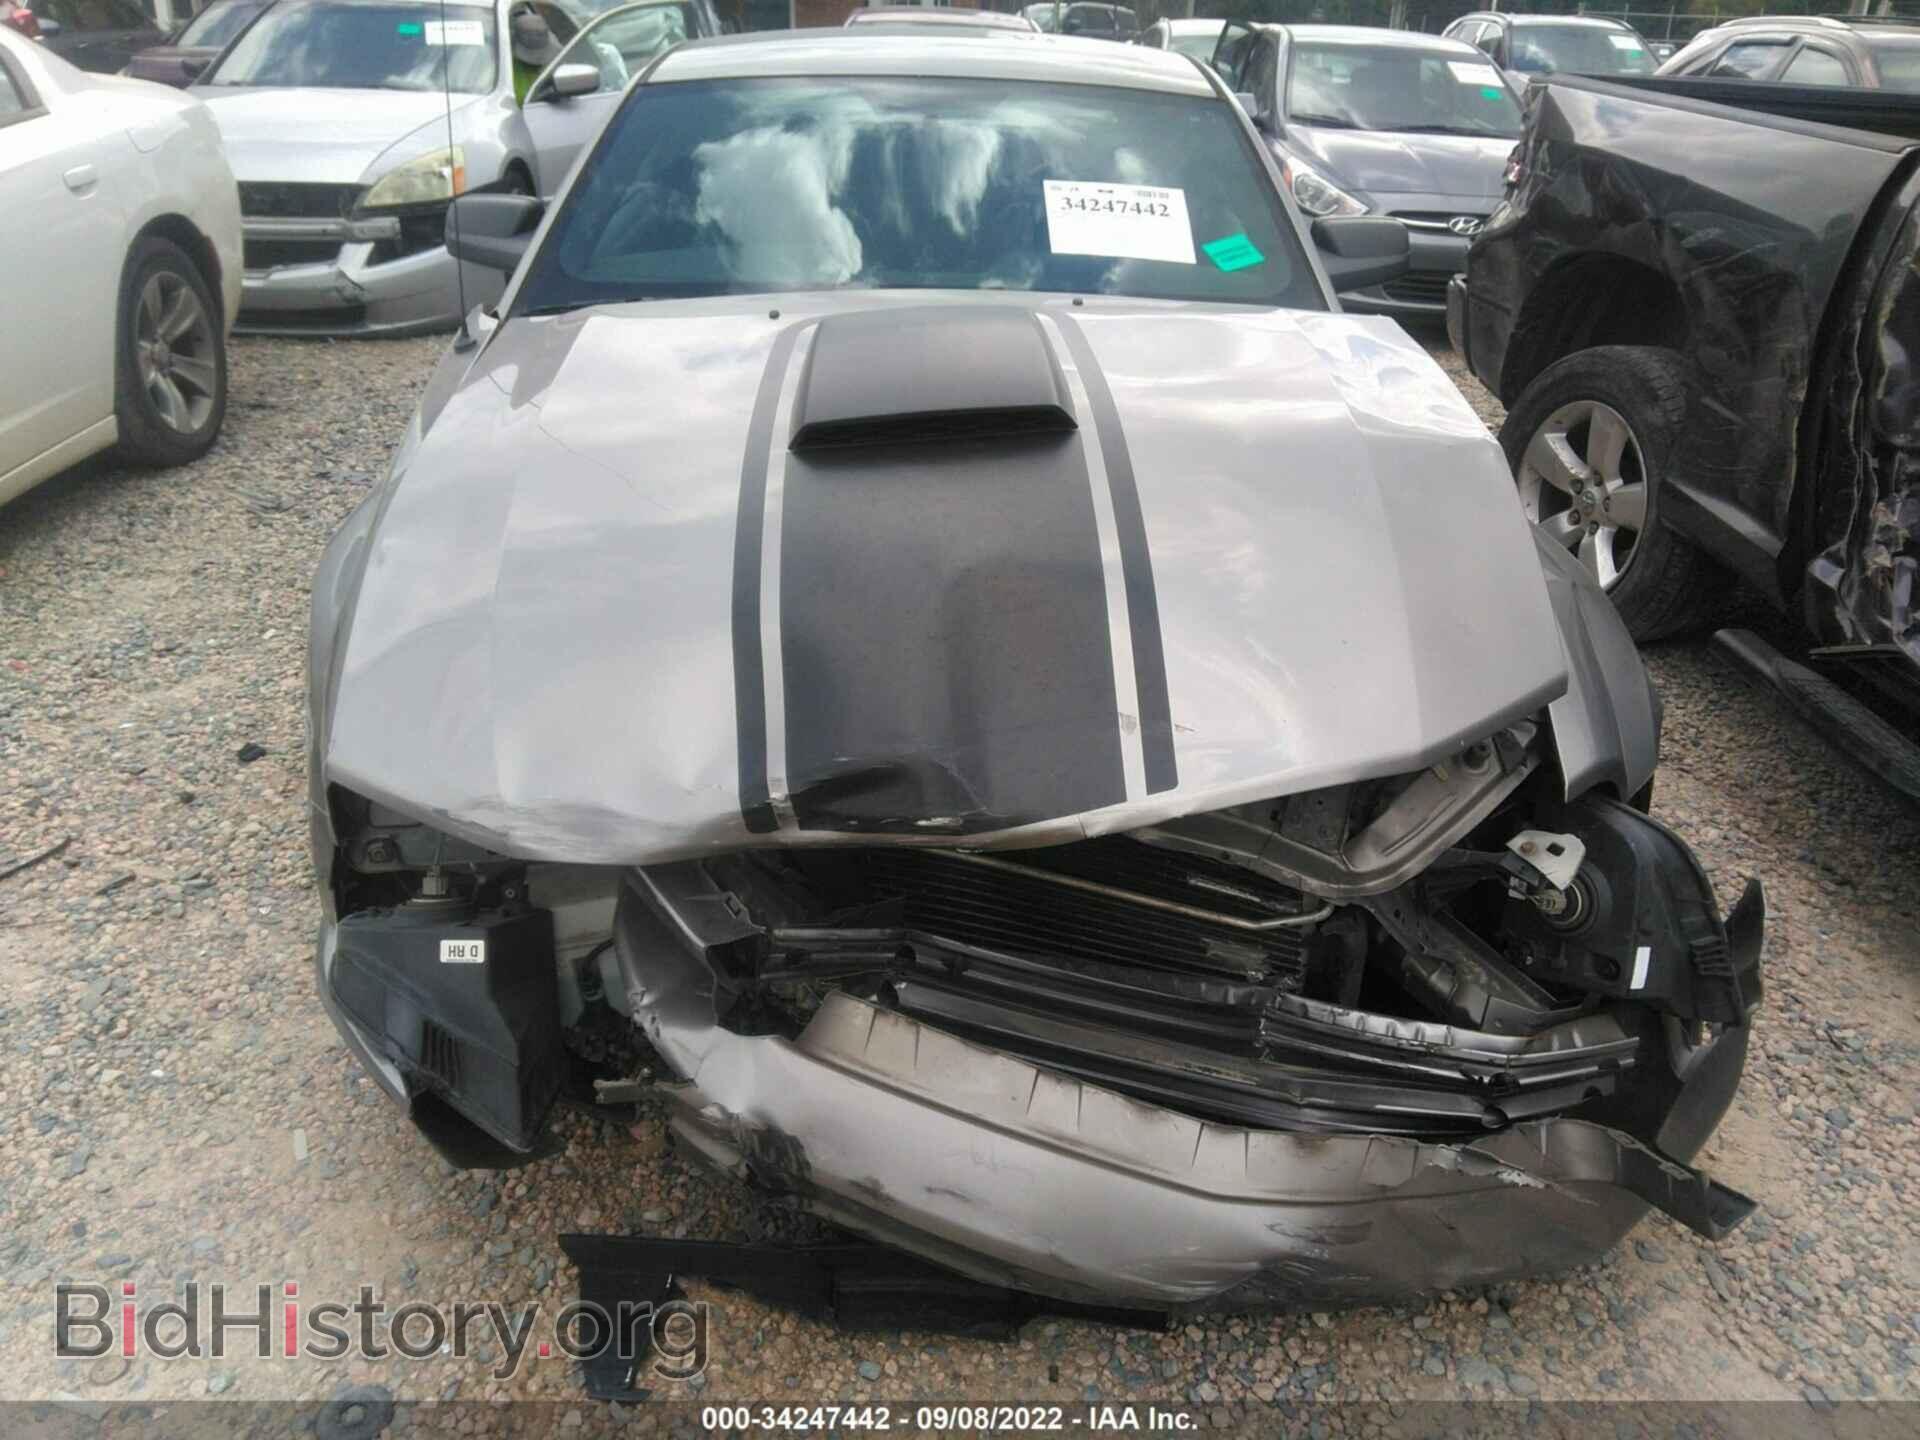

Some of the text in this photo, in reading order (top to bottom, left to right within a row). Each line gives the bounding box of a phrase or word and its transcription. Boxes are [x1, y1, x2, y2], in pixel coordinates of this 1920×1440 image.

[1060, 196, 1170, 218] 34247442
[447, 944, 479, 958] D RH
